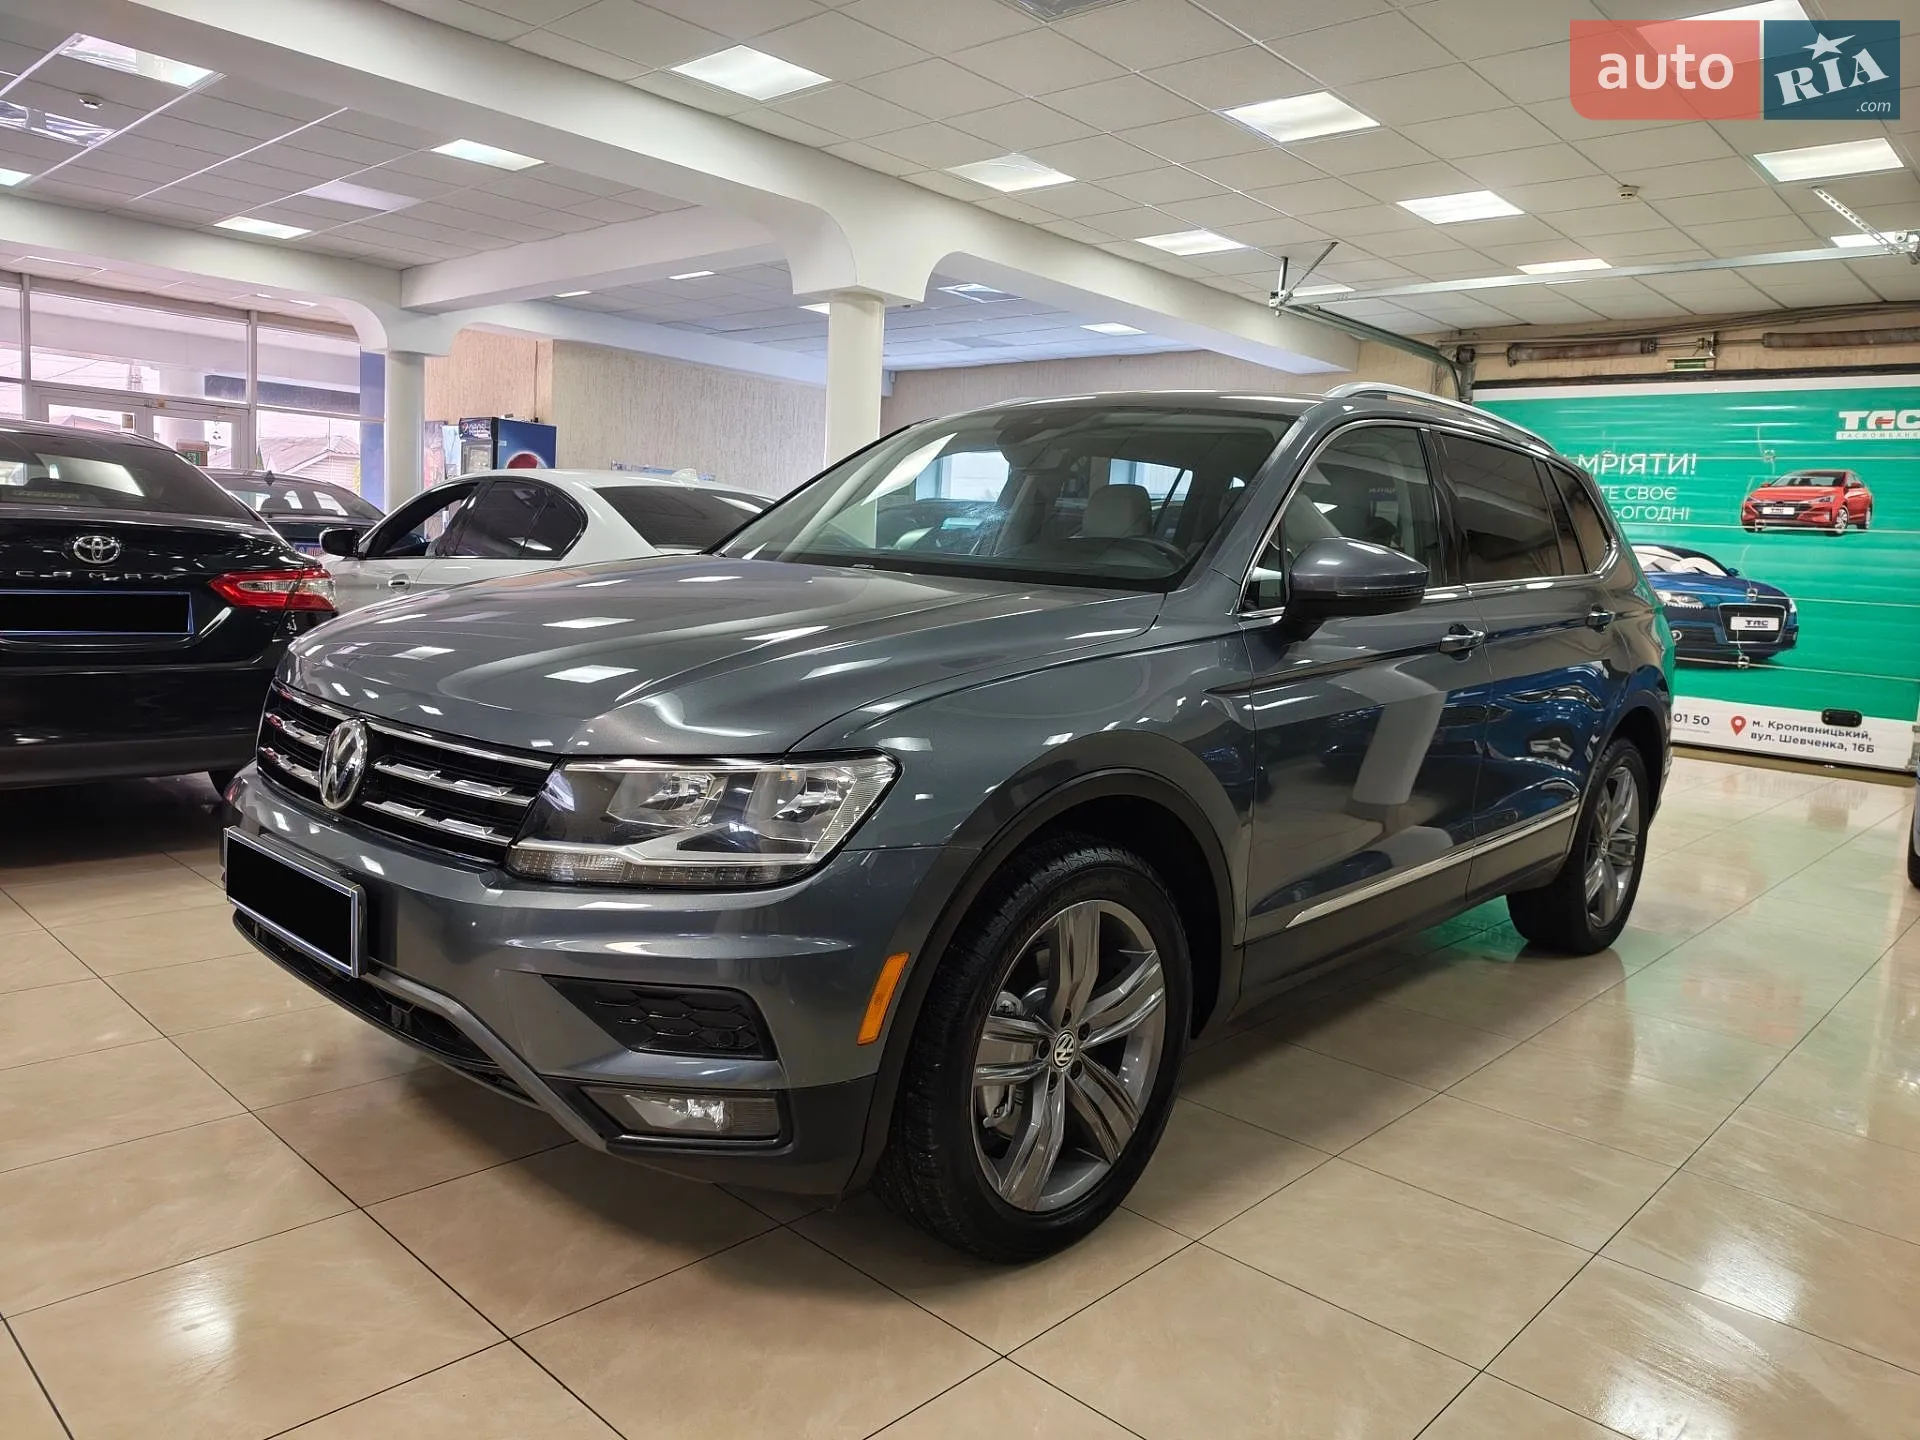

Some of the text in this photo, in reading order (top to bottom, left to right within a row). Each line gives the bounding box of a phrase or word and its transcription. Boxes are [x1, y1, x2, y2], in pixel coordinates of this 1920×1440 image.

[1578, 452, 1697, 475] МРІЯТИ!
[1599, 485, 1678, 501] ТЕ СВОЄ
[1673, 712, 1710, 726] 01 50
[1752, 719, 1873, 741] м. Кропивницький,
[1750, 731, 1875, 753] вул. Шевченка, 16Б
